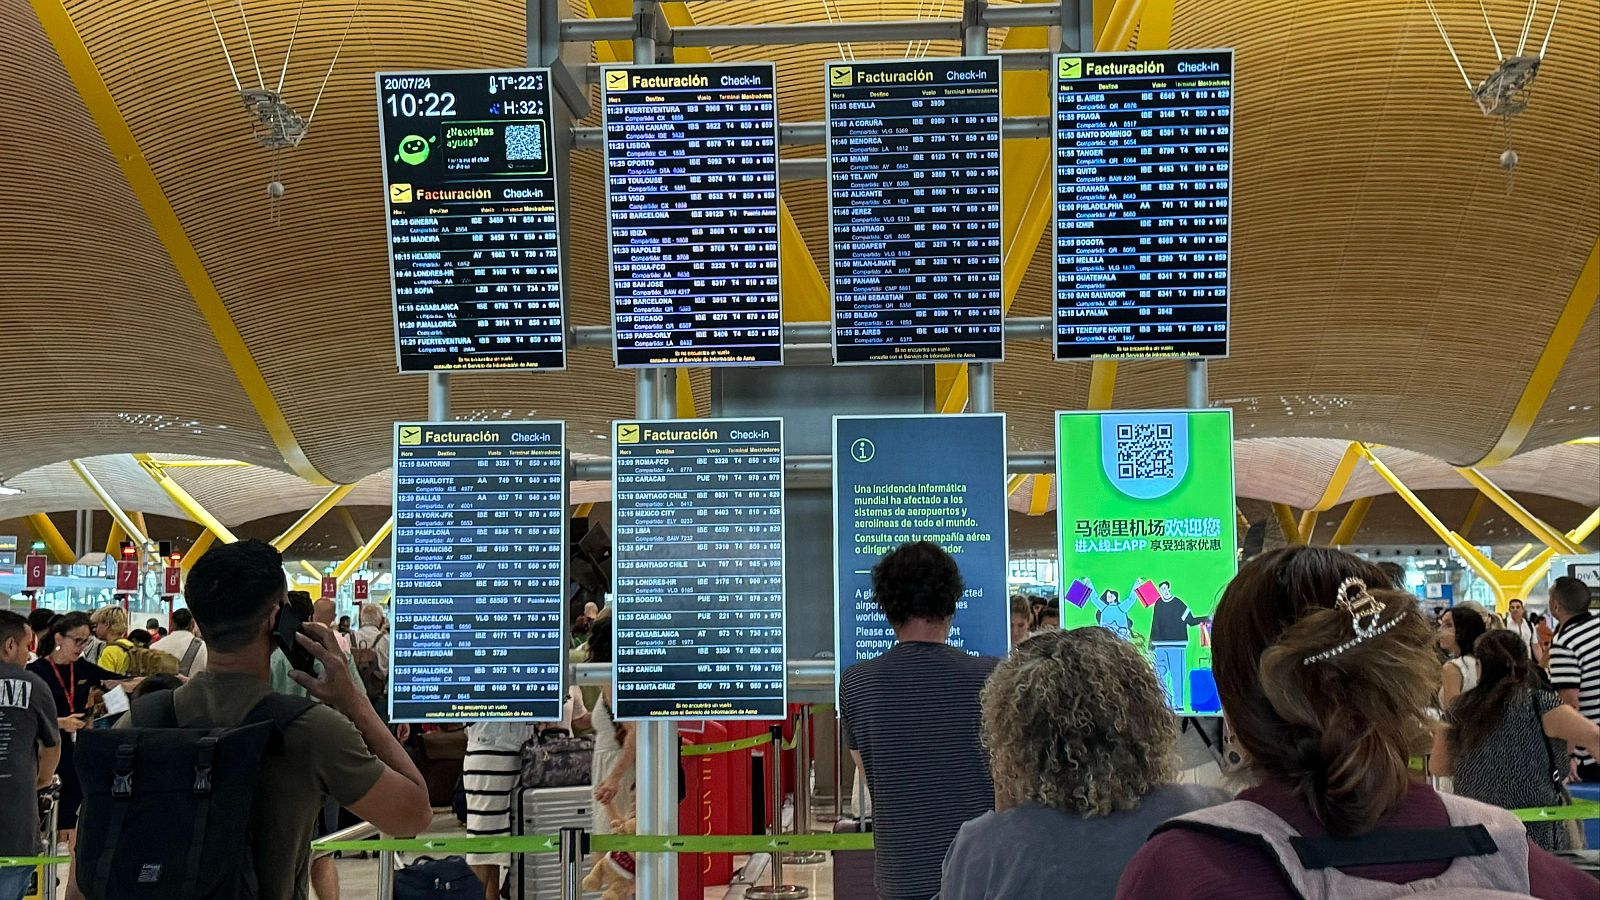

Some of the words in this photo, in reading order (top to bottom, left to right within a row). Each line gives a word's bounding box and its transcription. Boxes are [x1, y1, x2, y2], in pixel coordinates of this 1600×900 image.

[1086, 61, 1164, 75] Facturación
[1178, 62, 1219, 72] Check-in
[633, 75, 708, 88] Facturación
[721, 76, 760, 85] Check-in
[857, 70, 933, 83] Facturación
[947, 70, 986, 80] Check-in
[385, 78, 431, 90] 20/07/24
[387, 93, 456, 117] 10:22
[447, 138, 479, 149] ayuda?
[416, 188, 492, 200] Facturación
[504, 188, 543, 198] Check-in
[426, 431, 499, 443] Facturación
[512, 432, 550, 442] Check-in
[644, 428, 718, 441] Facturación
[730, 430, 769, 439] Check-in
[855, 485, 871, 493] Una
[873, 484, 915, 493] incidencia
[918, 483, 966, 492] informática
[855, 496, 888, 504] mundial
[891, 496, 901, 504] ha
[904, 496, 941, 504] afectado
[951, 495, 963, 503] los
[855, 508, 892, 516] sistemas
[894, 507, 905, 516] de
[908, 507, 959, 518] aeropuertos
[962, 507, 967, 516] y
[855, 519, 898, 528] aerolíneas
[901, 519, 911, 527] de
[914, 519, 933, 527] todo
[936, 518, 944, 527] el
[946, 518, 977, 527] mundo.
[1075, 518, 1220, 537] 马德里机场欢迎您
[855, 533, 892, 542] Consulta
[923, 533, 964, 544] compañía
[1150, 539, 1221, 551] 享受独家优惠
[33, 566, 40, 578] 6
[124, 571, 131, 582] 7
[170, 575, 176, 586] 8
[856, 589, 861, 598] A
[856, 627, 883, 636] Please
[856, 640, 892, 649] company
